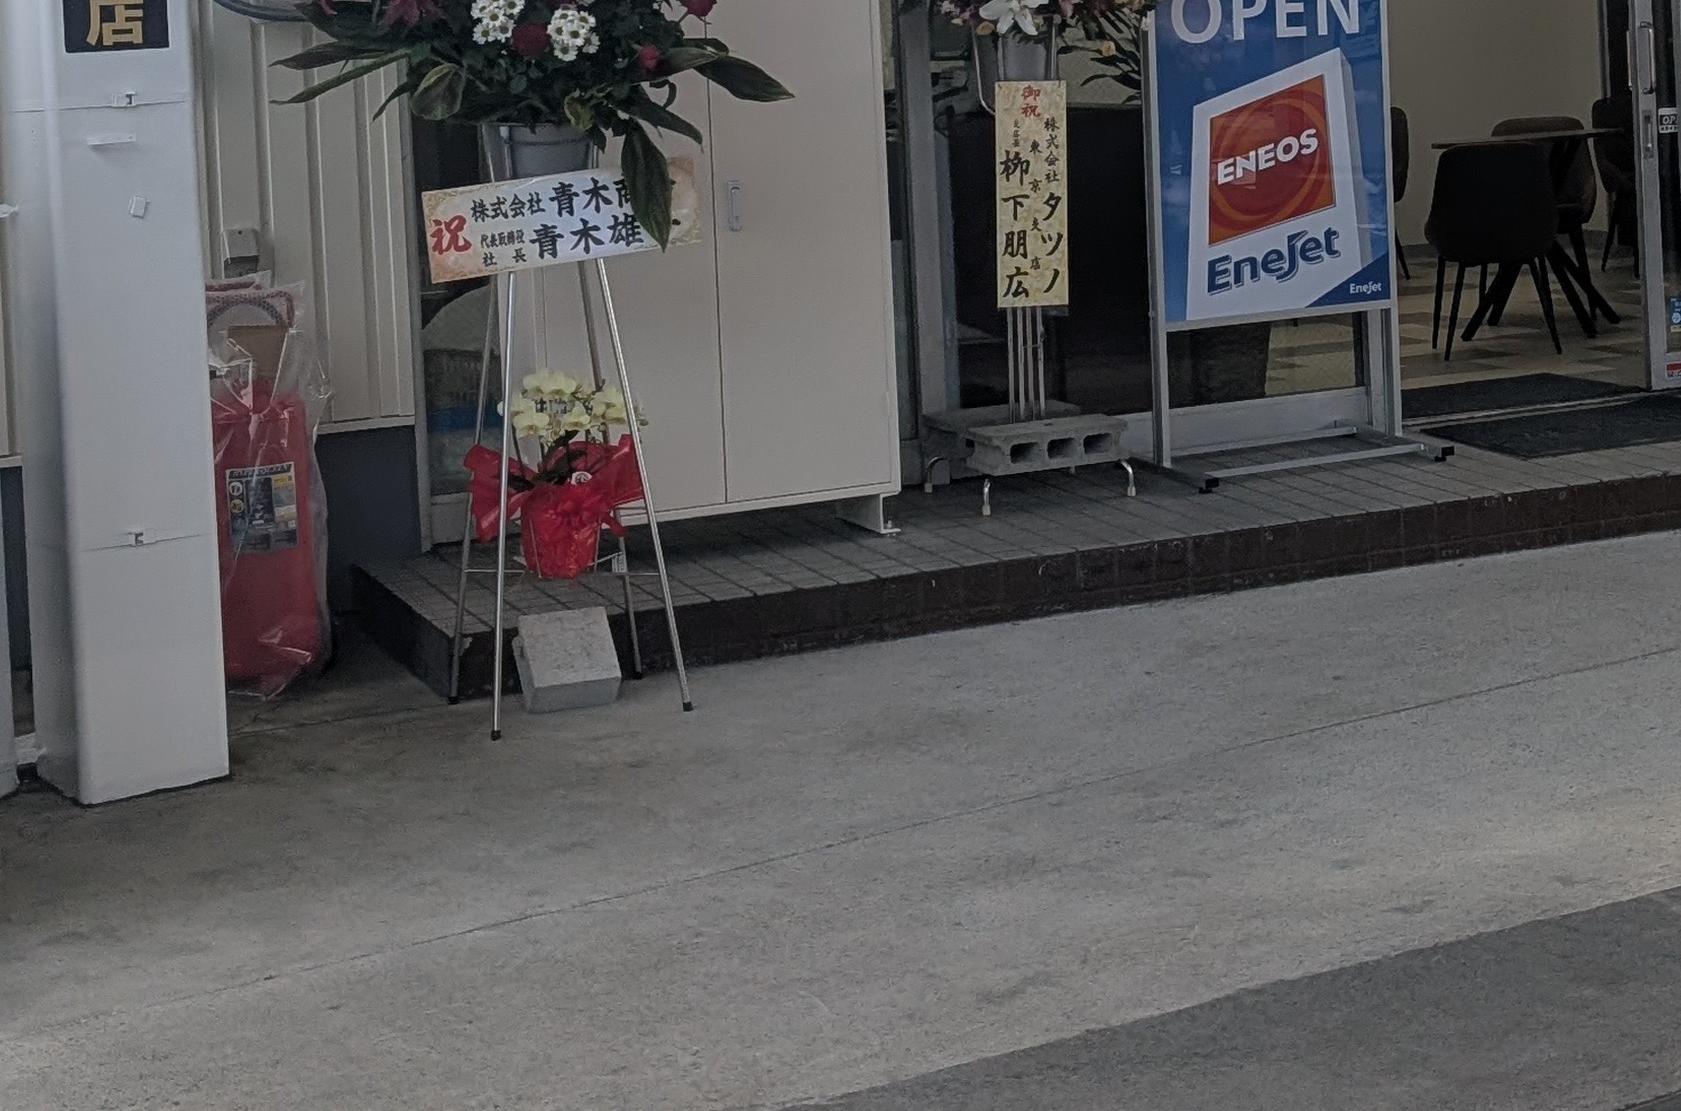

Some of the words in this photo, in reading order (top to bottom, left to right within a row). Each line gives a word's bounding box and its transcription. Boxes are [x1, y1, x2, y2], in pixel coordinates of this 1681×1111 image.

[1020, 84, 1041, 118] 御祝
[1662, 115, 1678, 125] OP
[1216, 128, 1319, 186] ENEOS
[431, 214, 472, 255] 祝
[530, 212, 681, 260] 青木雄
[1207, 226, 1342, 296] EneJet
[1349, 280, 1382, 296] EneJet
